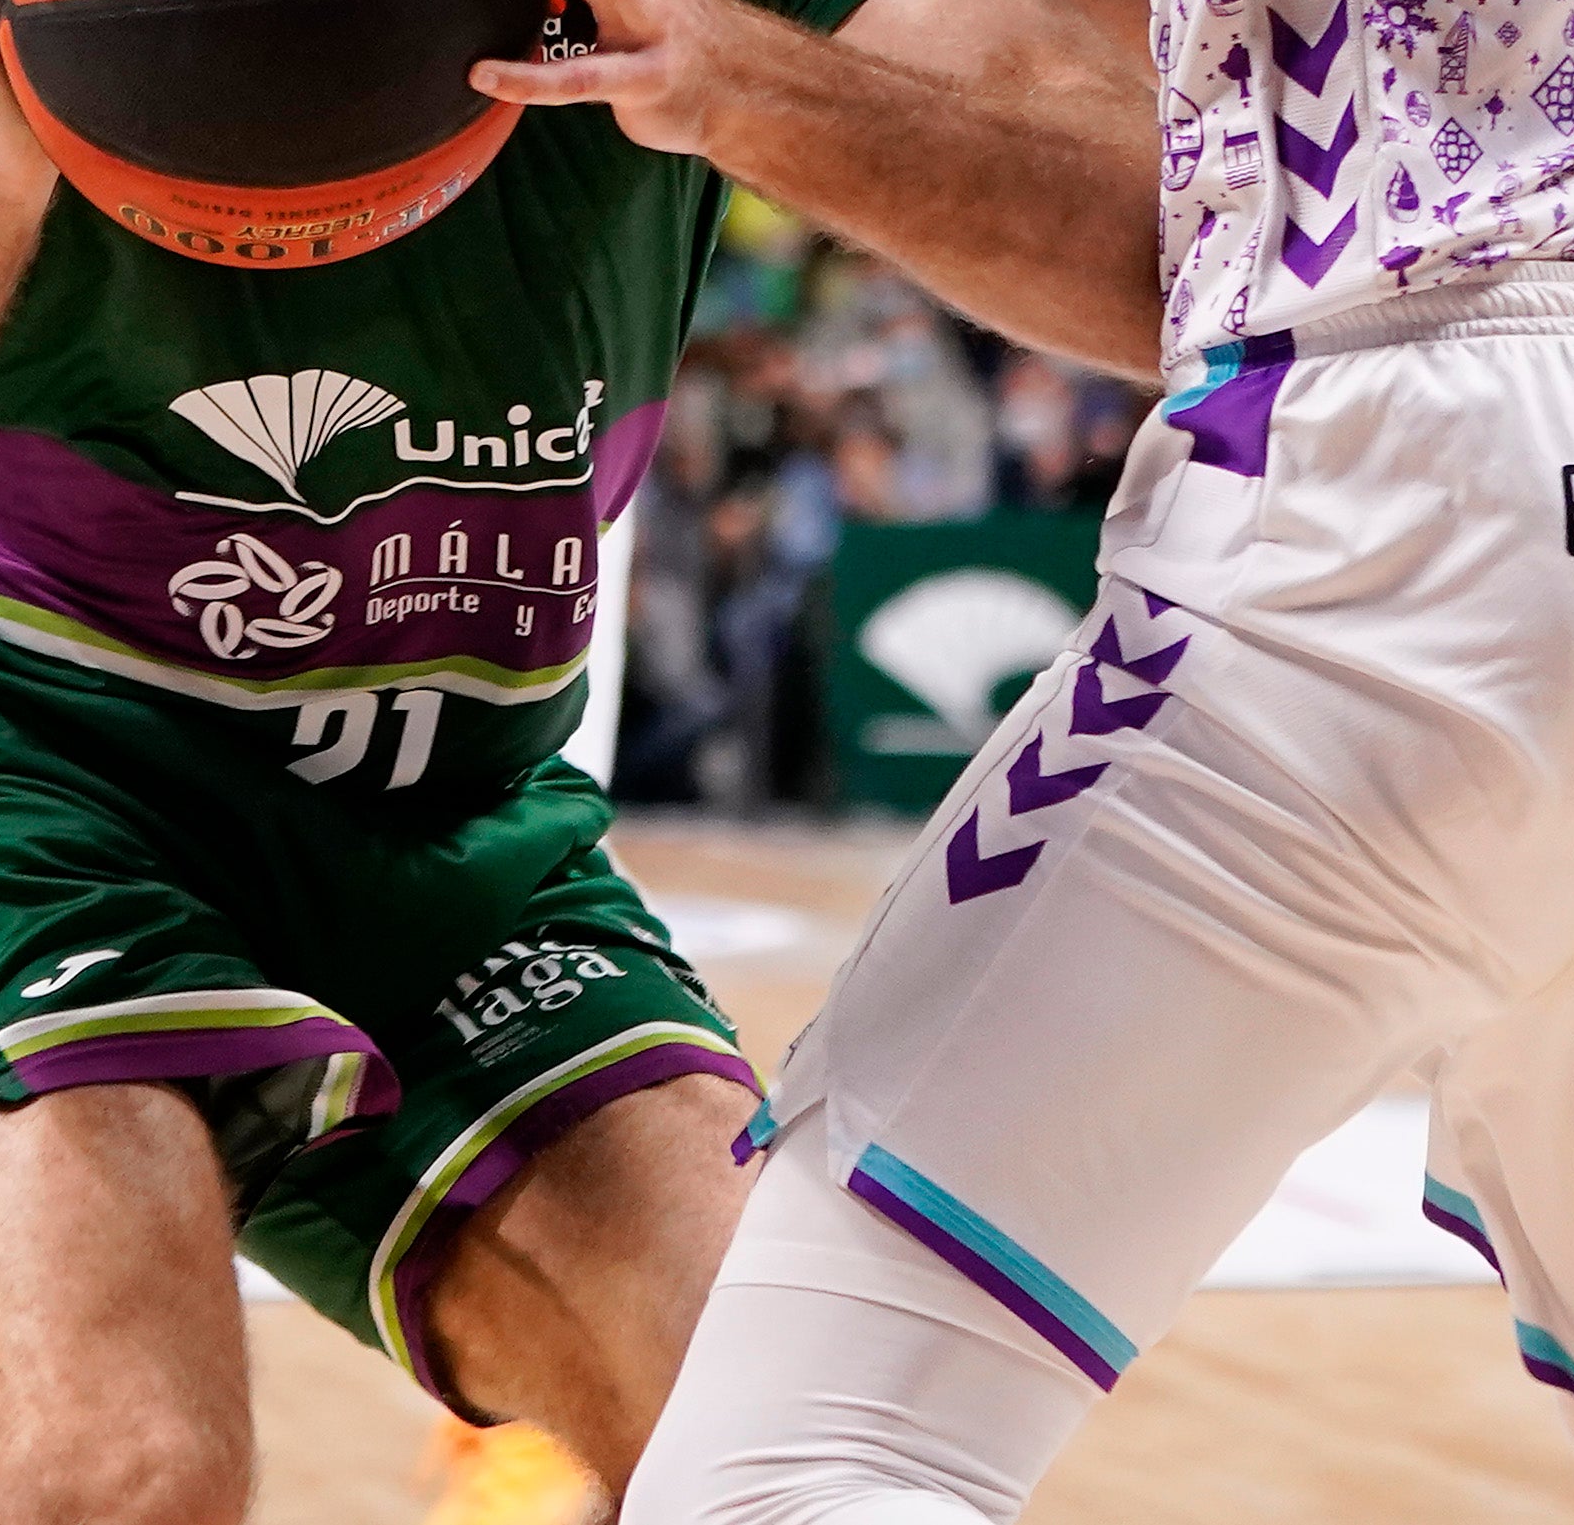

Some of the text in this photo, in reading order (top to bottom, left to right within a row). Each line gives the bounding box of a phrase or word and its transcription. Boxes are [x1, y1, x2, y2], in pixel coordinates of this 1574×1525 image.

[234, 209, 375, 242] LEGACY
[366, 585, 481, 626] Deporte
[515, 604, 535, 637] y
[434, 950, 628, 1046] laga
